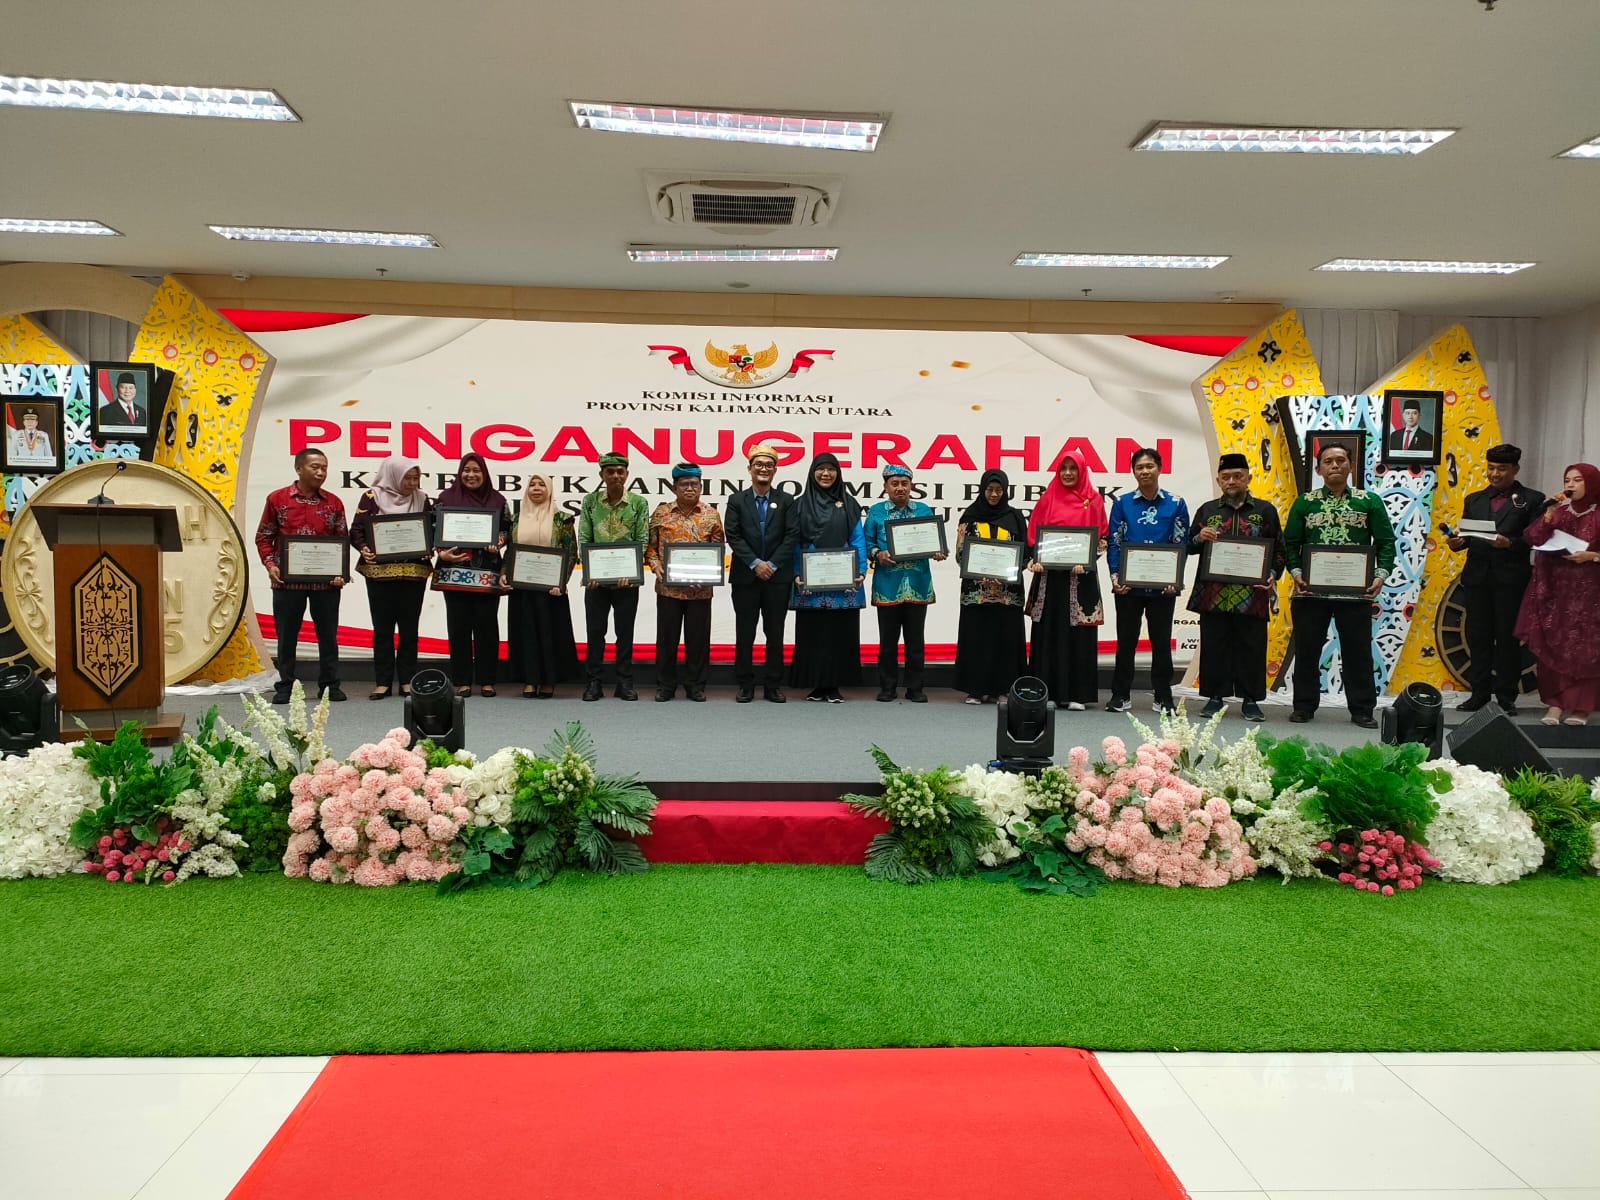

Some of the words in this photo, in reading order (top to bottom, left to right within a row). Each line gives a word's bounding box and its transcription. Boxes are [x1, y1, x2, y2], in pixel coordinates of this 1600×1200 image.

[642, 390, 717, 401] KOMISI
[722, 392, 834, 404] INFORMASI
[586, 401, 684, 413] PROVINSI
[689, 403, 821, 415] KALIMANTAN
[828, 407, 893, 417] UTARA
[289, 418, 1174, 474] PENGANUGERAHAN
